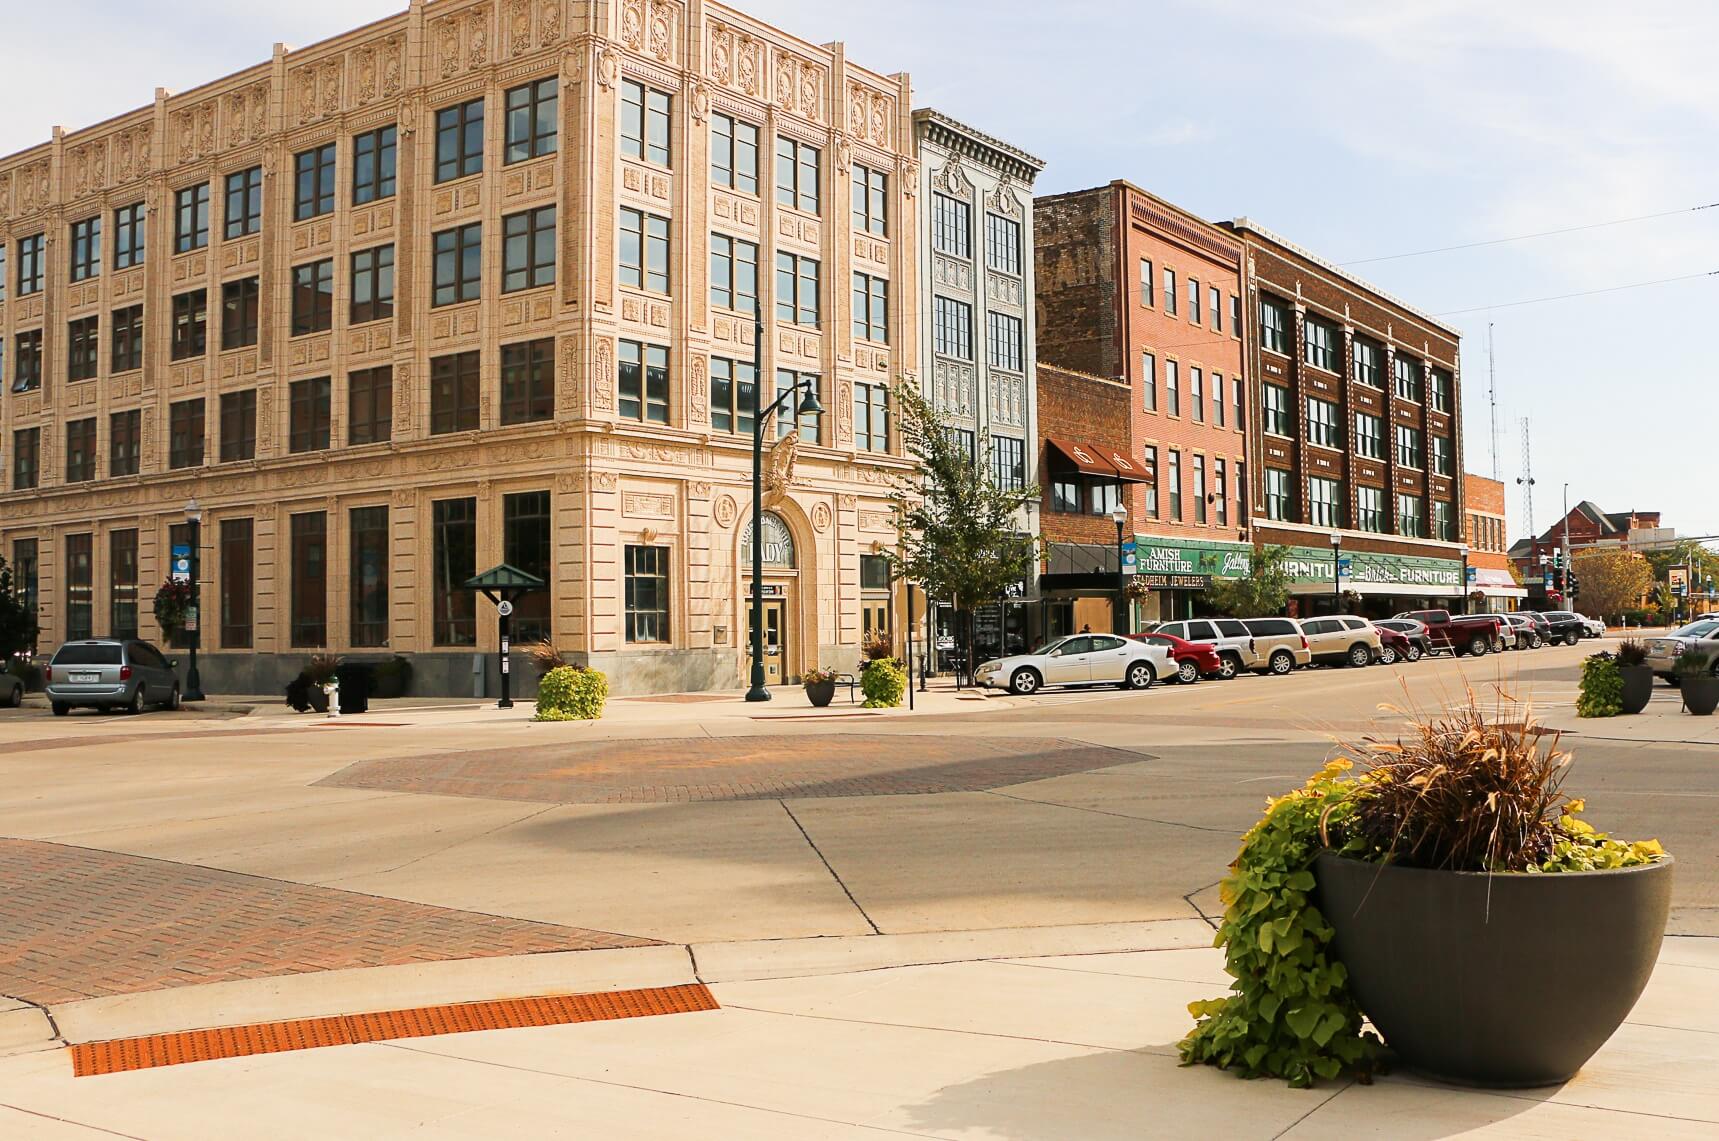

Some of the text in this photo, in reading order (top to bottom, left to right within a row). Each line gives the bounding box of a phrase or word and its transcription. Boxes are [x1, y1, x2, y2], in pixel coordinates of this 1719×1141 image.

[1149, 547, 1181, 560] AMISH
[1139, 558, 1193, 573] FURNITURE
[1170, 576, 1205, 587] JEWELERS
[1400, 568, 1460, 584] FURNITURE
